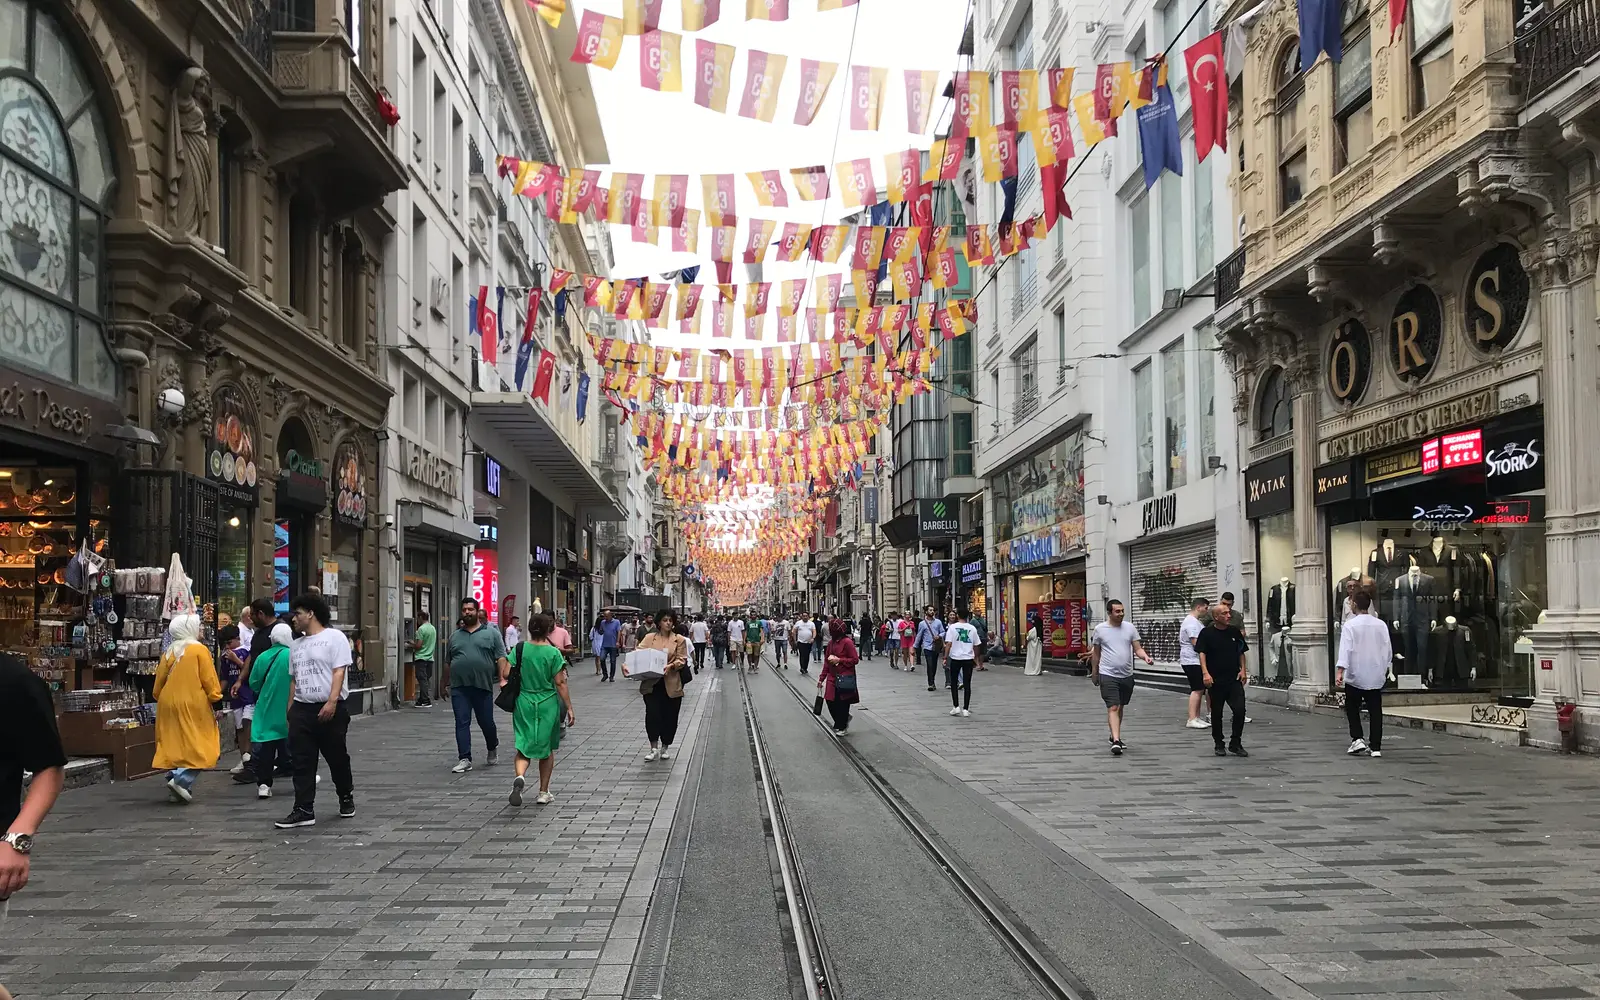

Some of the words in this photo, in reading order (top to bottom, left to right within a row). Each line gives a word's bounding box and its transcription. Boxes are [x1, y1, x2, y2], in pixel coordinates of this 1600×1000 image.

[1041, 124, 1061, 146] 23
[1443, 432, 1481, 445] EXCHANGE
[1449, 441, 1474, 452] OFFICE
[1369, 456, 1398, 470] WESTERN
[1485, 439, 1539, 478] STORKS
[1378, 463, 1398, 475] UNION
[922, 520, 958, 531] BARGELLO
[301, 668, 324, 677] LONELY
[305, 686, 323, 694] TIME
